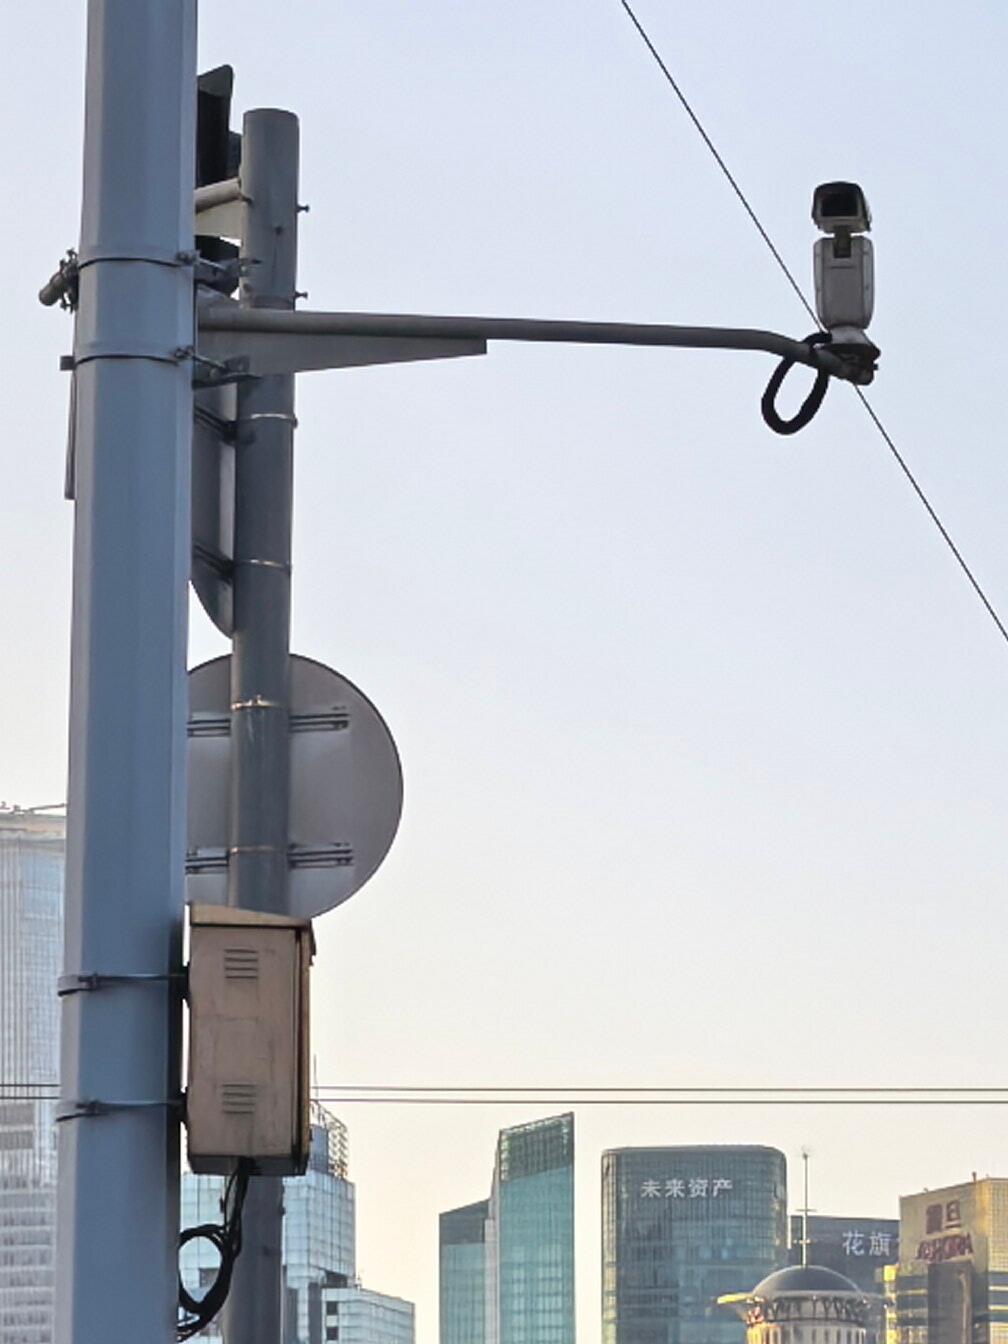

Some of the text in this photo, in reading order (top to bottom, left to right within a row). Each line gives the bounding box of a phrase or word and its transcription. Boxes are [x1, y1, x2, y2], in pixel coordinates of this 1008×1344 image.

[640, 1178, 733, 1198] 未来资产
[842, 1230, 900, 1256] 花旗
